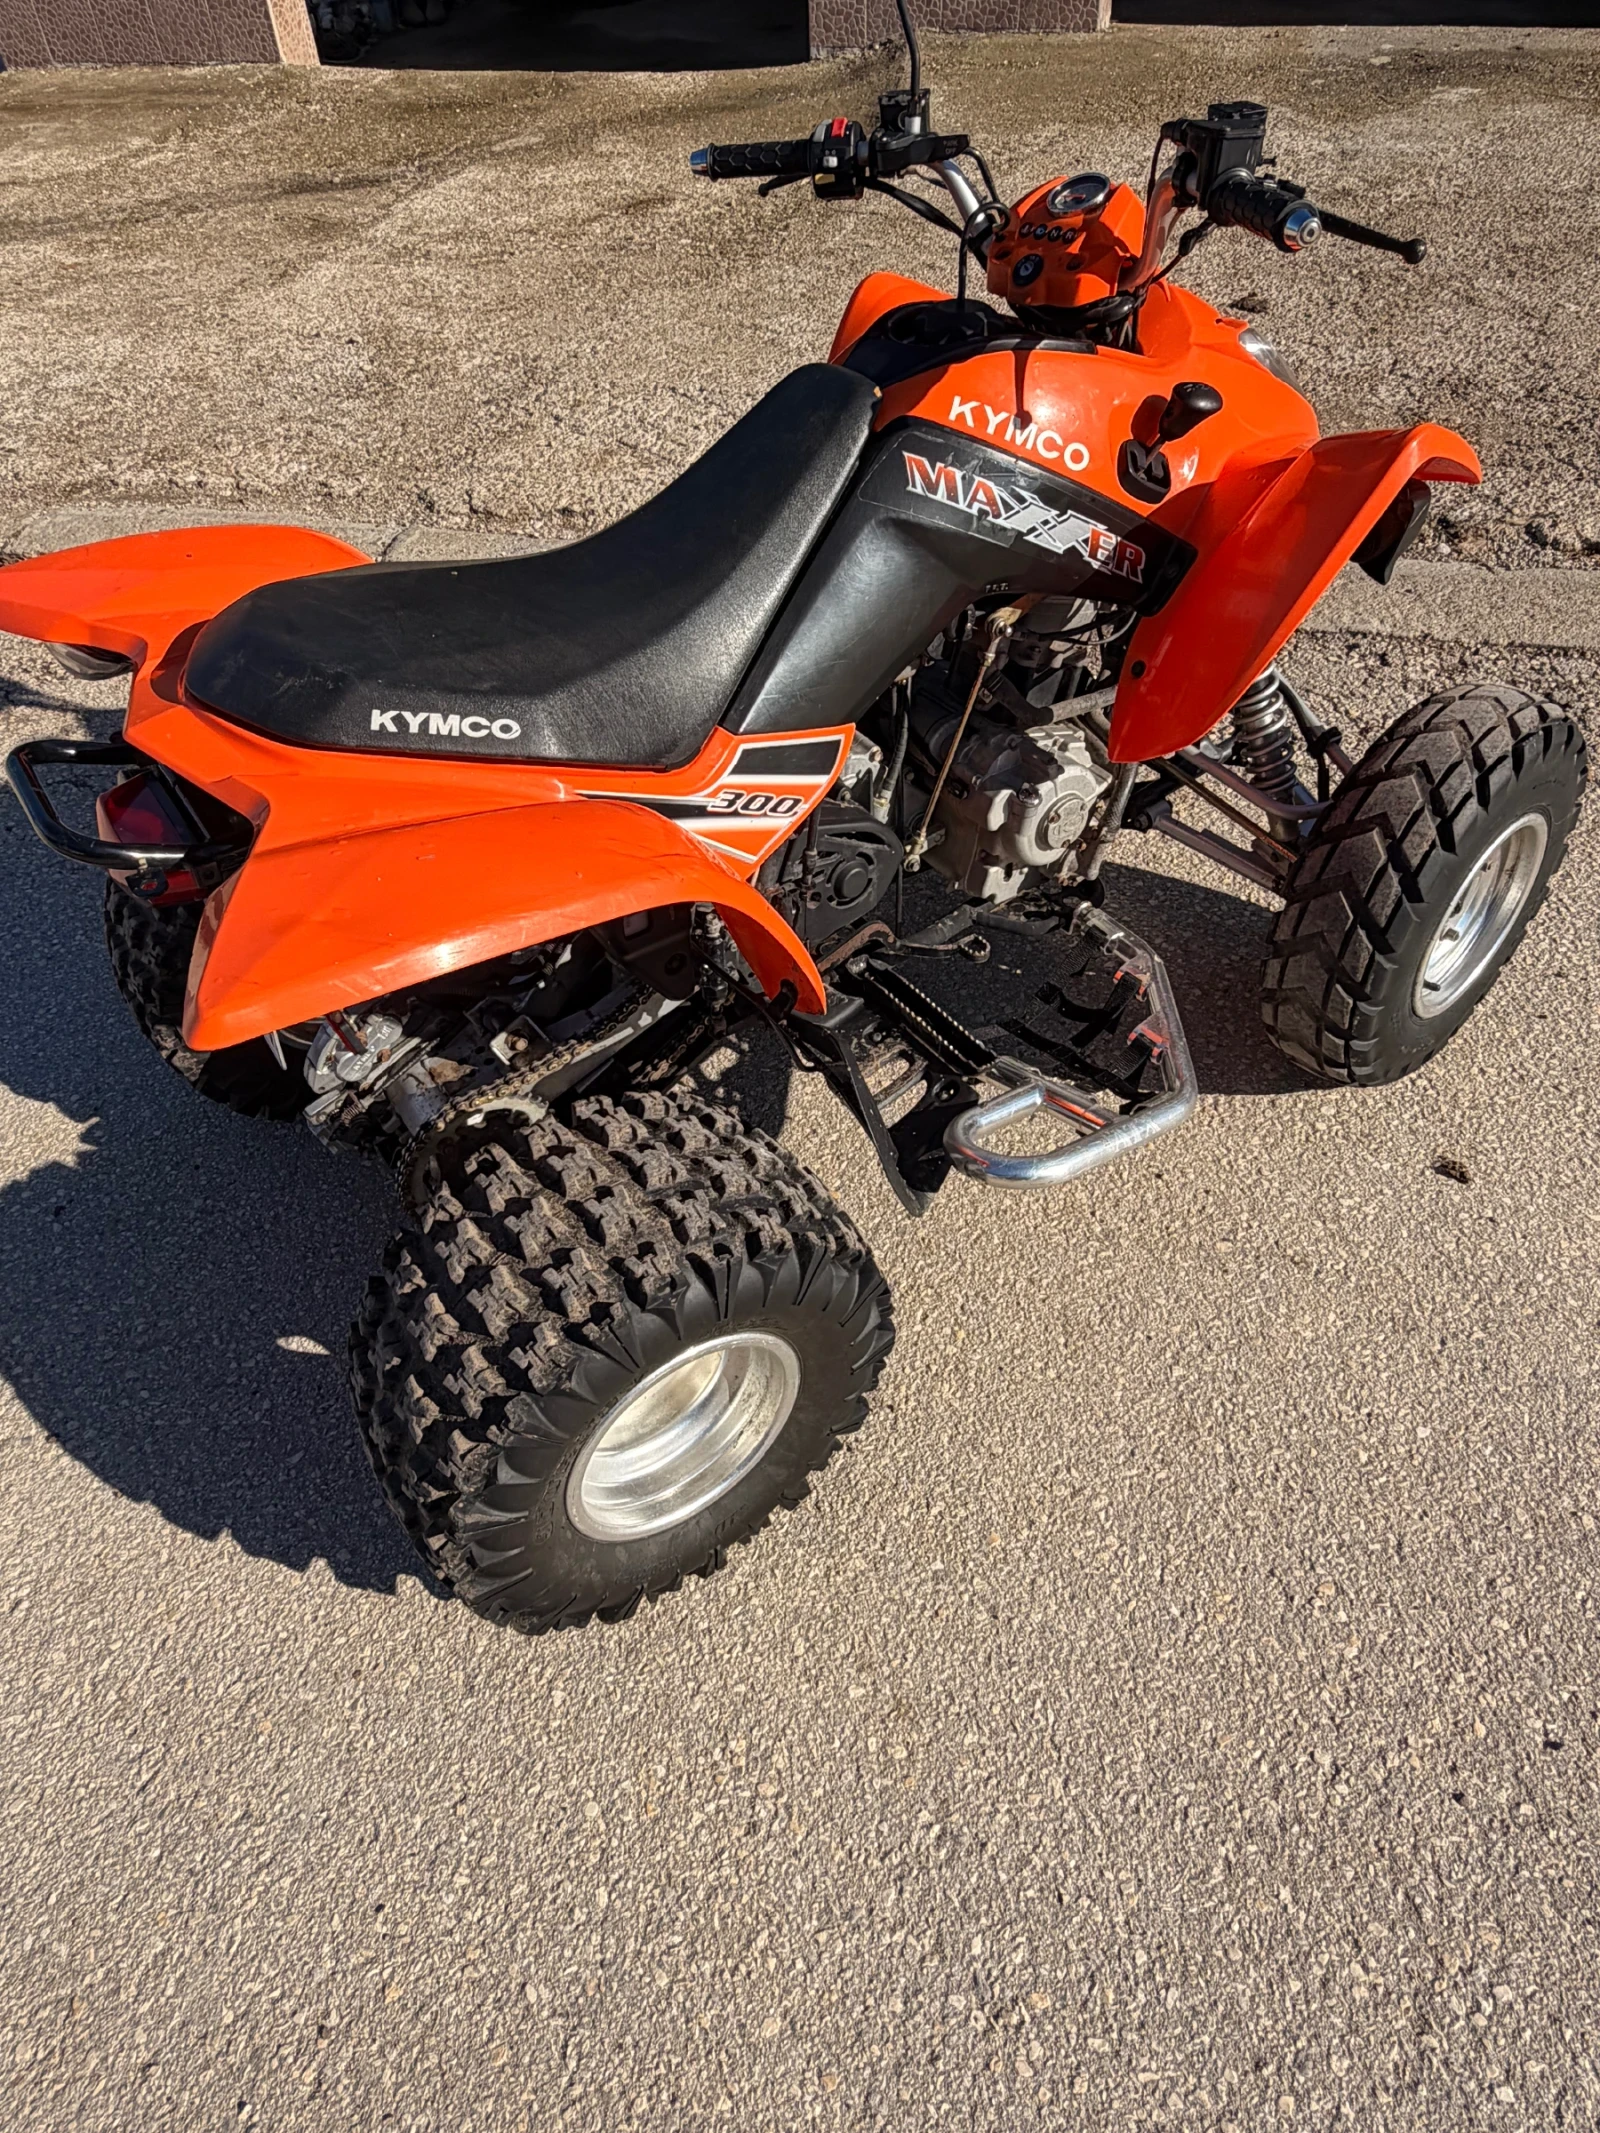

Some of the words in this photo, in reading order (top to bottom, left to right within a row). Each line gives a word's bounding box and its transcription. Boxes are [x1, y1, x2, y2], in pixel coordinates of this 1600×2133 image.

[948, 395, 1090, 471] KYMCO
[370, 709, 521, 739] KYMCO
[707, 788, 804, 817] 300
